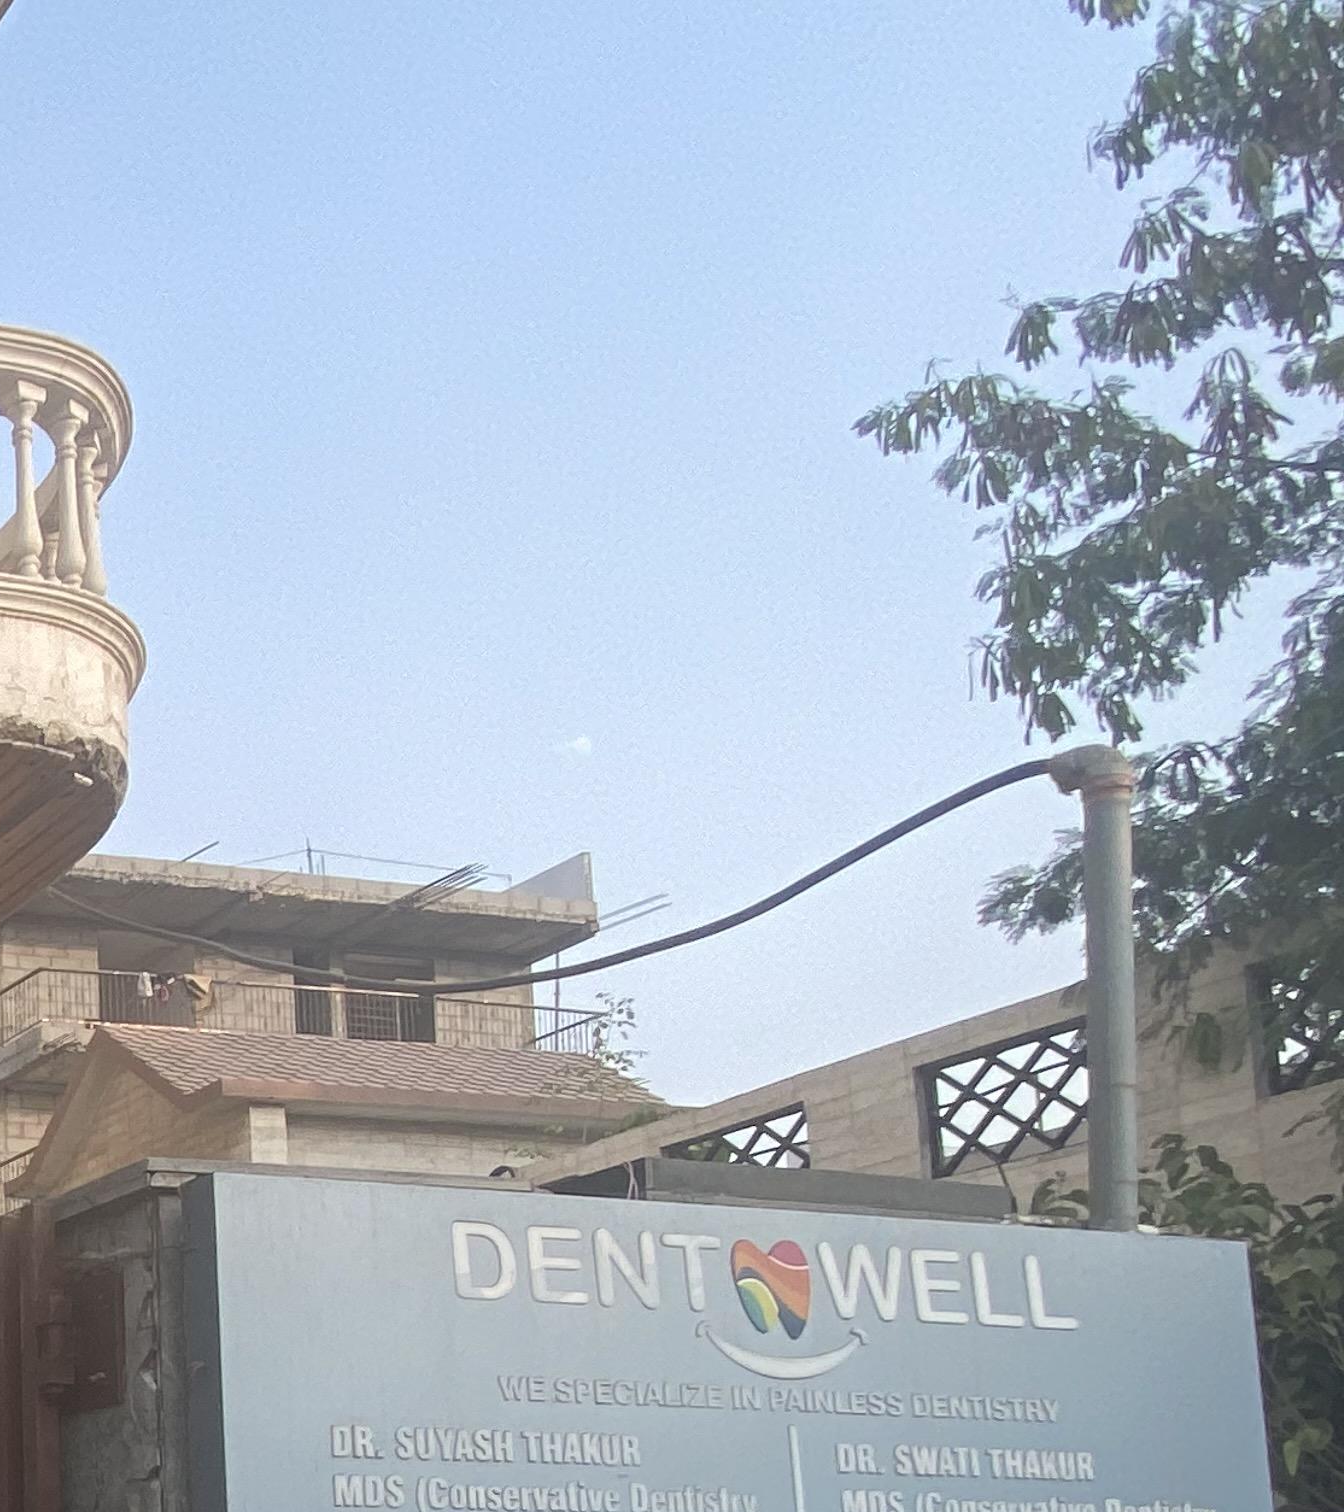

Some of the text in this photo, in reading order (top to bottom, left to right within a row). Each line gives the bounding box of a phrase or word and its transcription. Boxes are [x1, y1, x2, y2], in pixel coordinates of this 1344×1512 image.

[497, 1375, 1060, 1422] WE SPECIALIZE IN PAINLESS DENTISTRY
[330, 1425, 641, 1467] DR. SUYASH THAKUR
[835, 1443, 1095, 1481] DR. SWATI THAKUR
[332, 1474, 404, 1509] MDS
